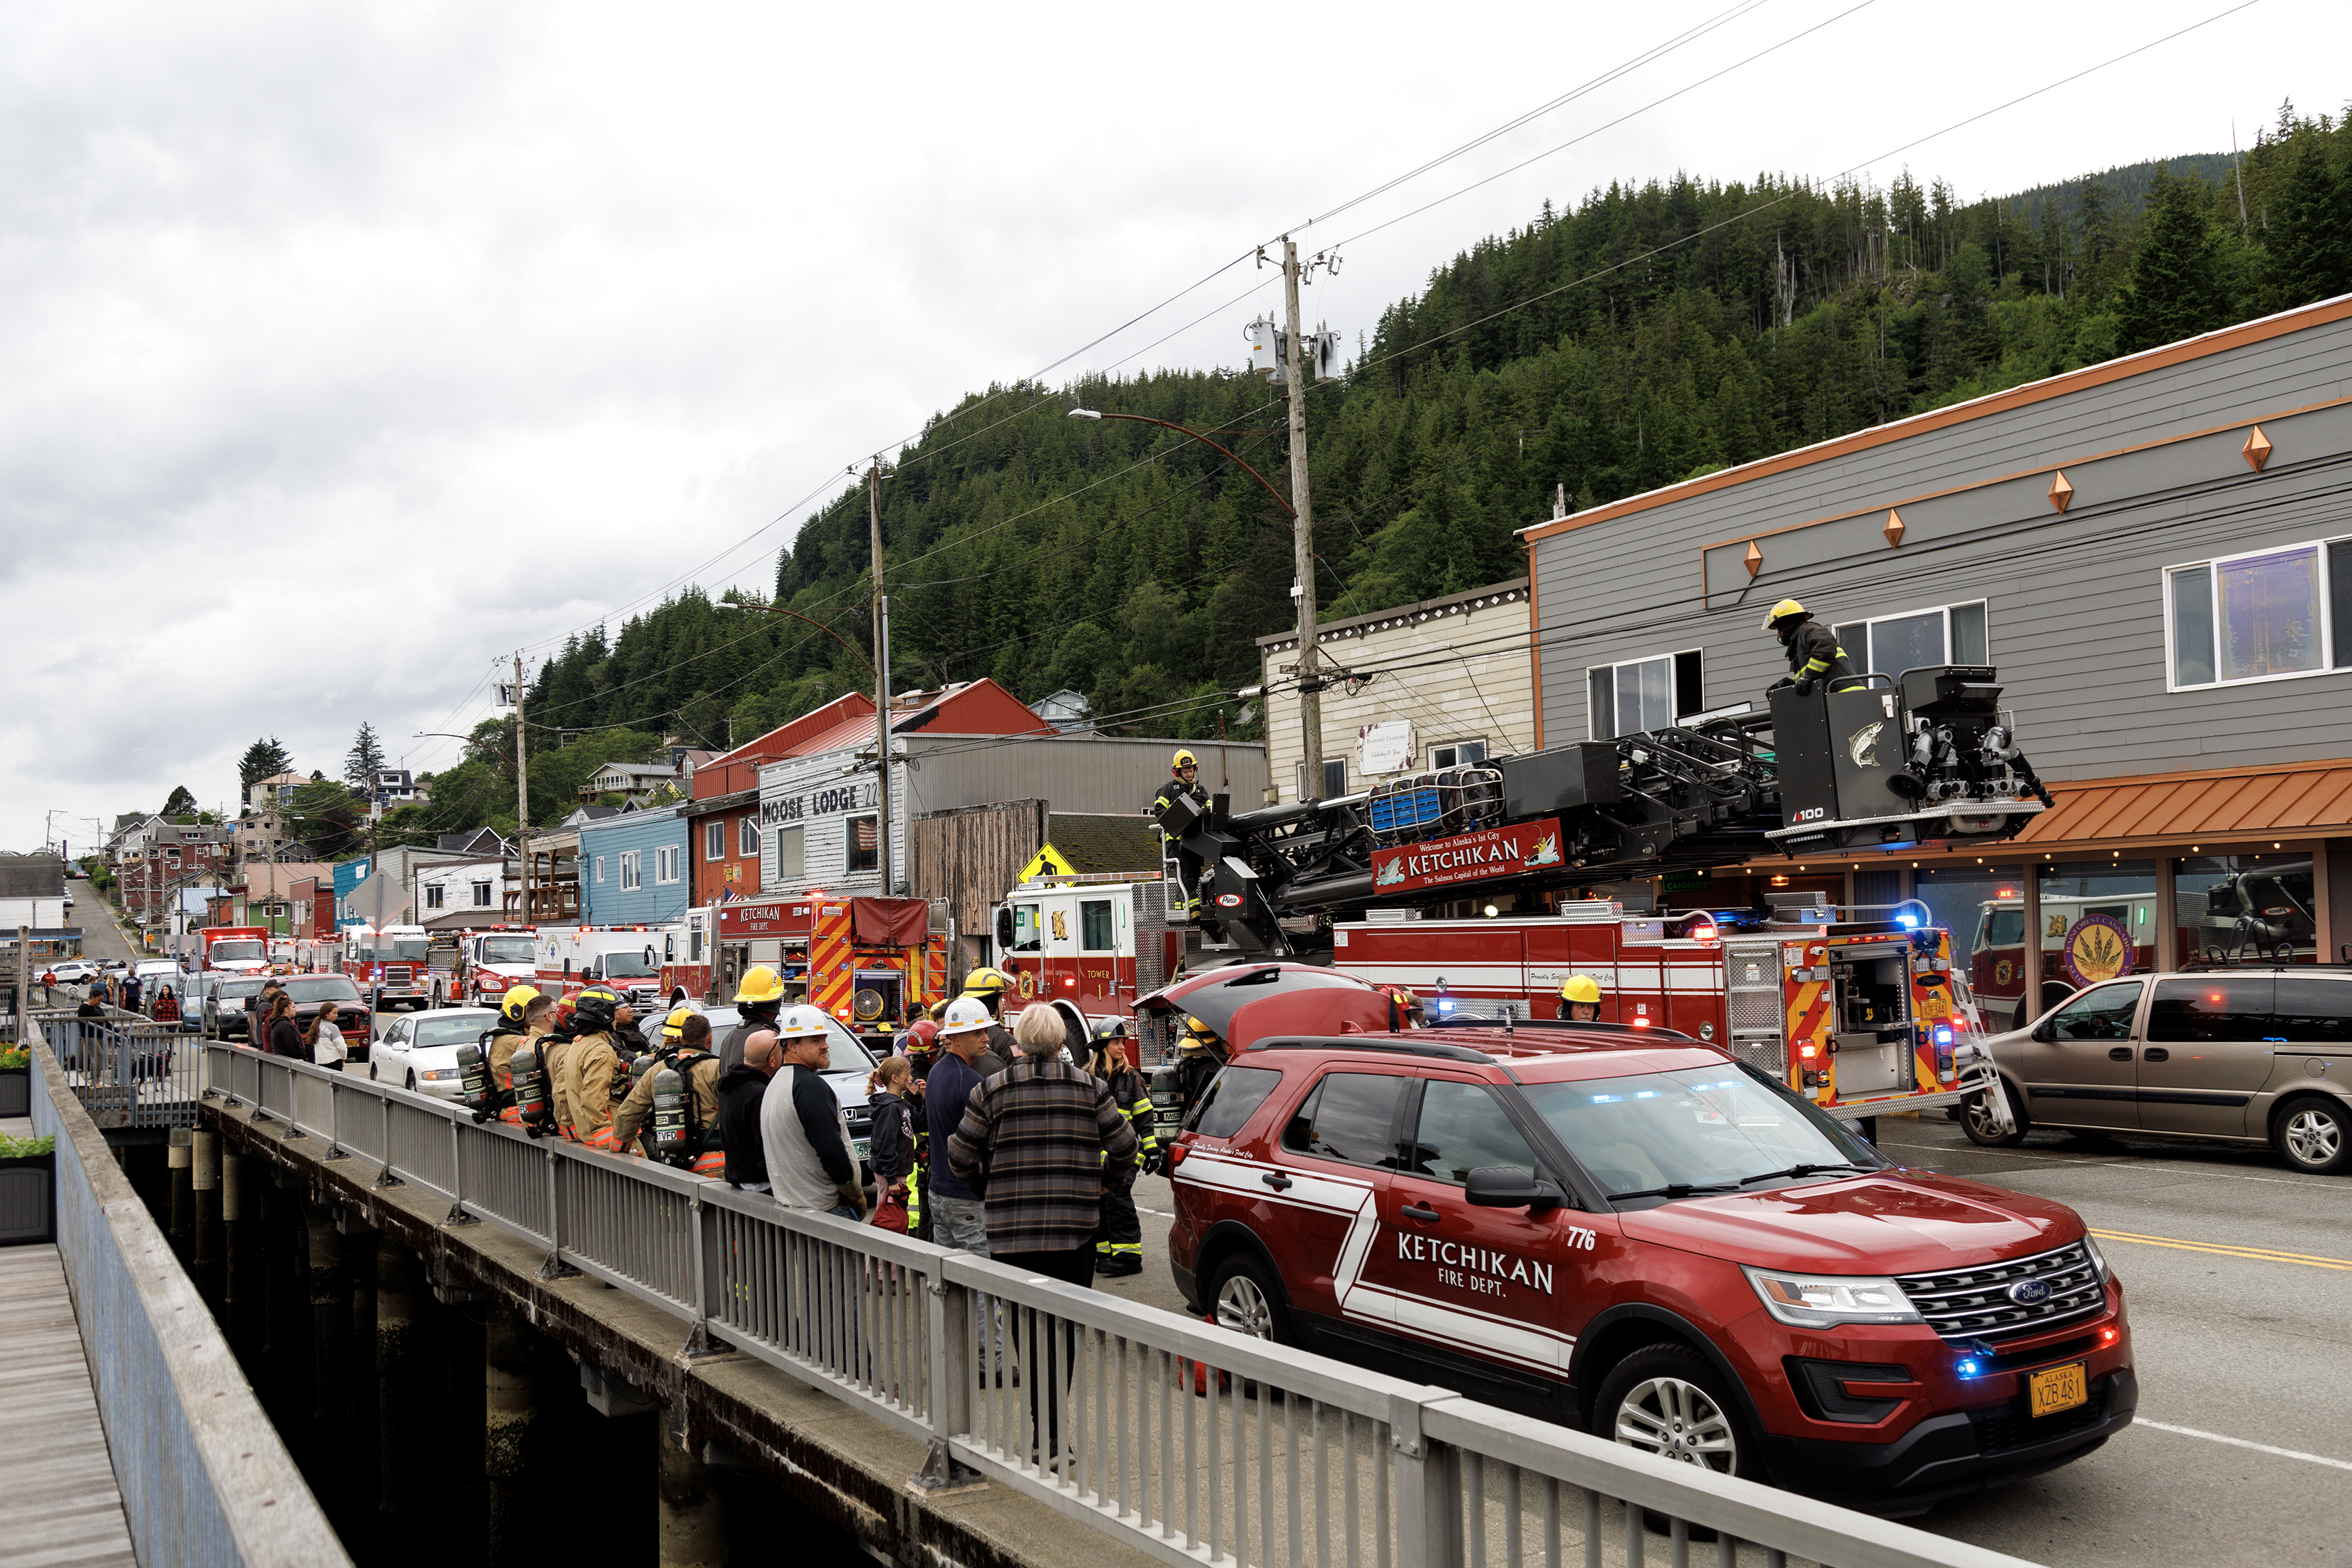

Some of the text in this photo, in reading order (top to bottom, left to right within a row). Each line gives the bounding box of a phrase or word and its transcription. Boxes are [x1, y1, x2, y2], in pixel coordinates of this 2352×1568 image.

[762, 796, 804, 825] MOOSE
[813, 785, 857, 815] LODGE
[1419, 843, 1445, 853] Welcome
[1453, 835, 1477, 846] Alaska's
[1487, 831, 1500, 841] City
[1408, 837, 1520, 879] KETCHIKAN
[1423, 865, 1505, 884] The Salmon Capital of the World
[1664, 872, 1709, 881] RAINFOREST
[1222, 895, 1238, 905] Pierce
[740, 906, 780, 924] KETCHIKAN
[758, 922, 768, 930] DEPT.
[2065, 917, 2131, 953] RAINFOREST CANNABIS
[1087, 970, 1110, 980] TOWER
[1097, 984, 1102, 1001] 1
[1924, 1004, 1945, 1016] XZF 344
[466, 1080, 483, 1089] MSA
[526, 1089, 542, 1098] MSA
[1193, 1142, 1207, 1151] Proudly
[1206, 1143, 1219, 1155] Serving
[1244, 1150, 1254, 1160] City
[1567, 1225, 1597, 1252] 776
[1398, 1232, 1554, 1296] KETCHIKAN
[1438, 1267, 1507, 1299] FIRE DEPT.
[2022, 1284, 2046, 1299] Ford
[2044, 1371, 2074, 1385] ALASKA
[2037, 1377, 2081, 1408] XZB 481
[2050, 1401, 2071, 1410] GOVERNMENT
